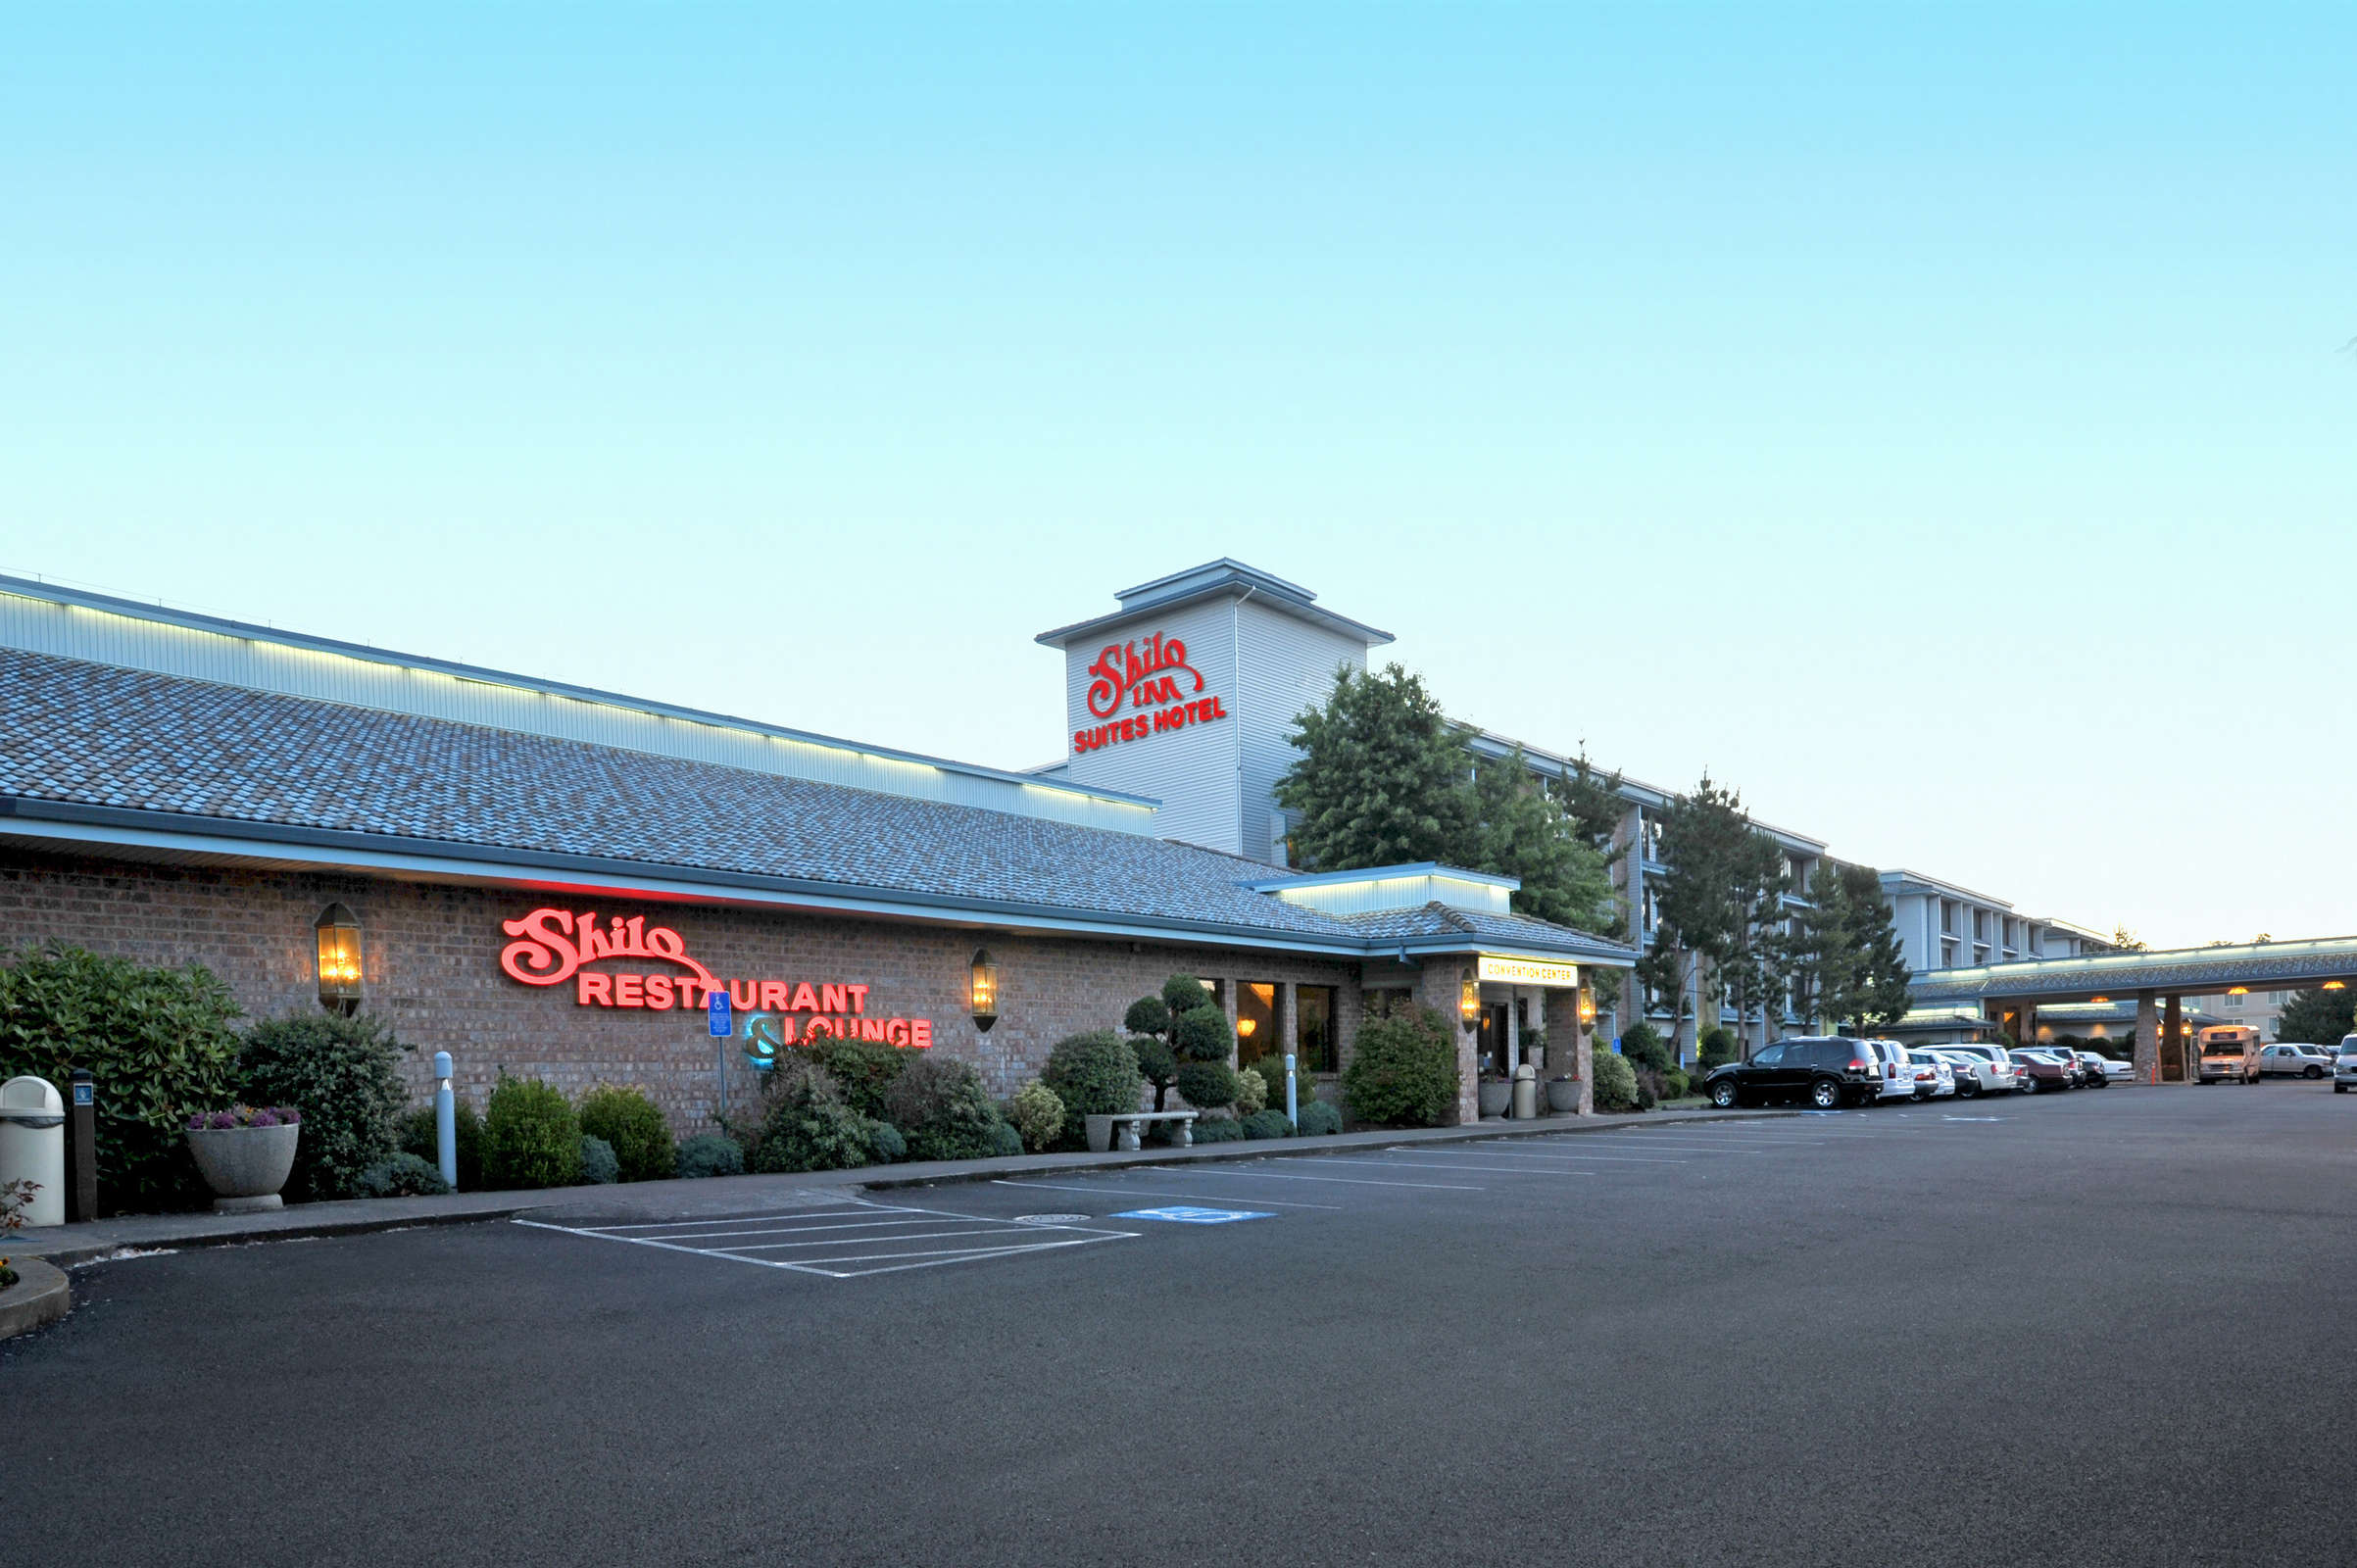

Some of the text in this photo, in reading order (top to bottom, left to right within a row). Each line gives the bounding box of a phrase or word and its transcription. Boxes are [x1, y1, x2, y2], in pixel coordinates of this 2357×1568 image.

[1087, 631, 1204, 718] Shilo
[1074, 696, 1226, 753] SUITES HOTEL
[501, 907, 720, 991] Shilo
[1488, 963, 1571, 980] CONVENTION CENTER
[746, 1015, 782, 1060] &
